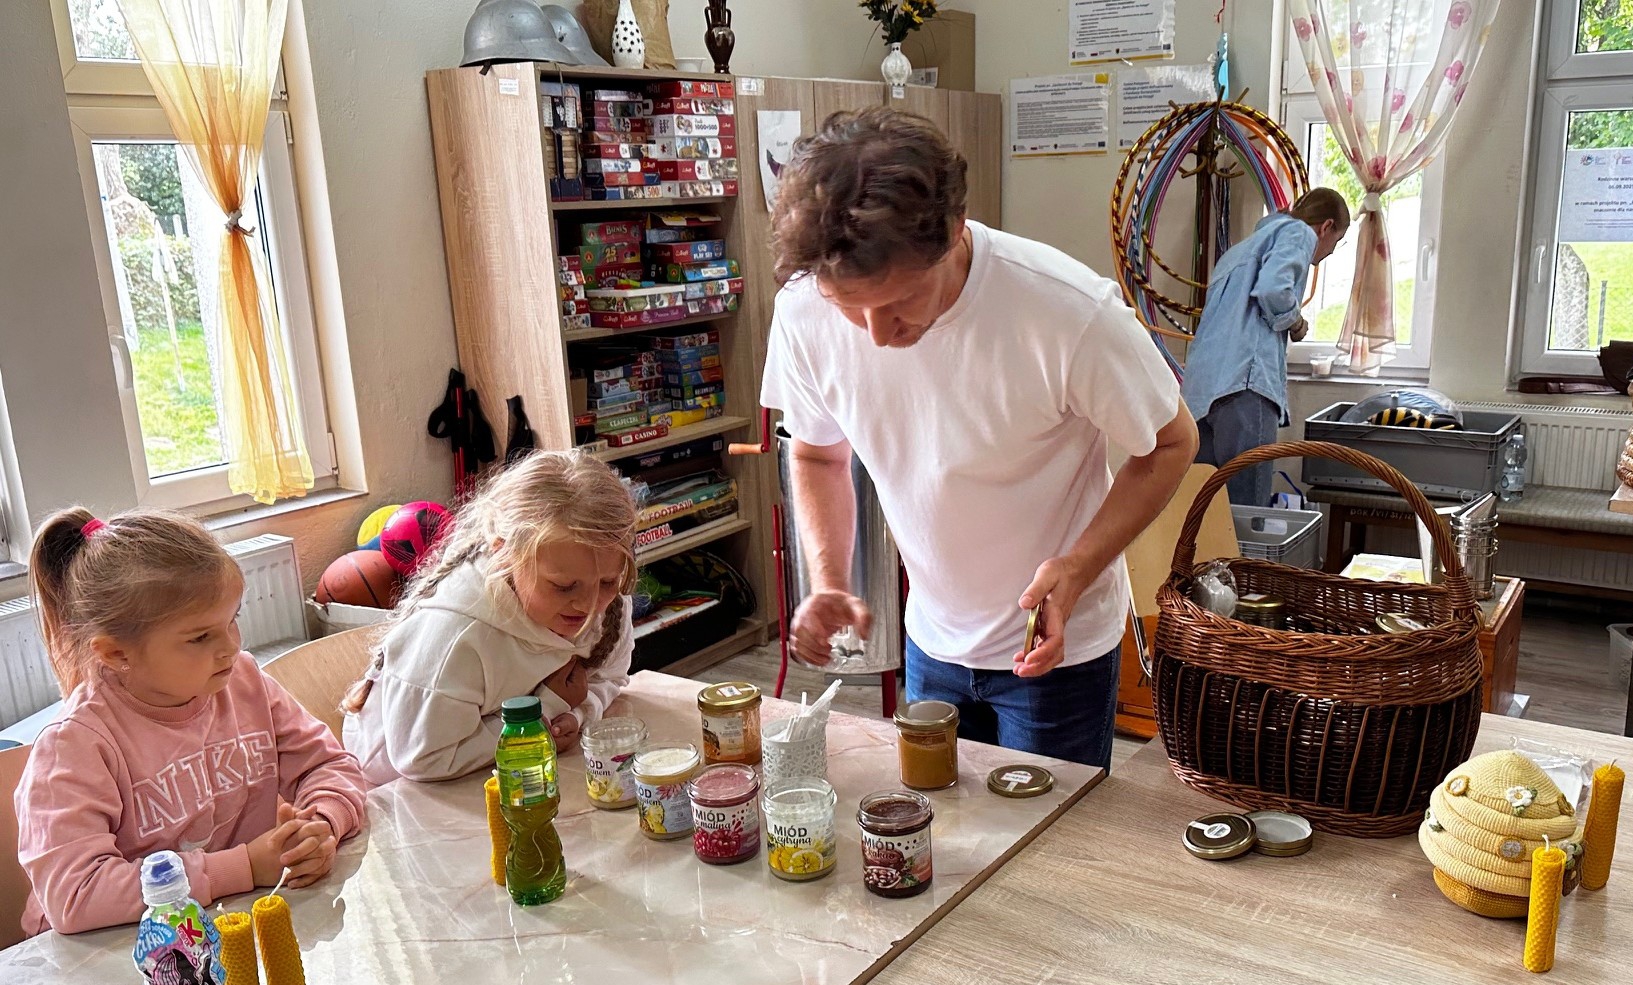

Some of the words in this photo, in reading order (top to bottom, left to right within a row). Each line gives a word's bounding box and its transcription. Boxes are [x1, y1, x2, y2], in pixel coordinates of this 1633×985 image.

[635, 429, 657, 440] CASINO
[636, 523, 673, 547] FOOTBALL
[133, 731, 278, 838] NIKE
[695, 809, 726, 822] MIÓD
[774, 824, 808, 838] MIÓD
[864, 836, 895, 850] MIÓD
